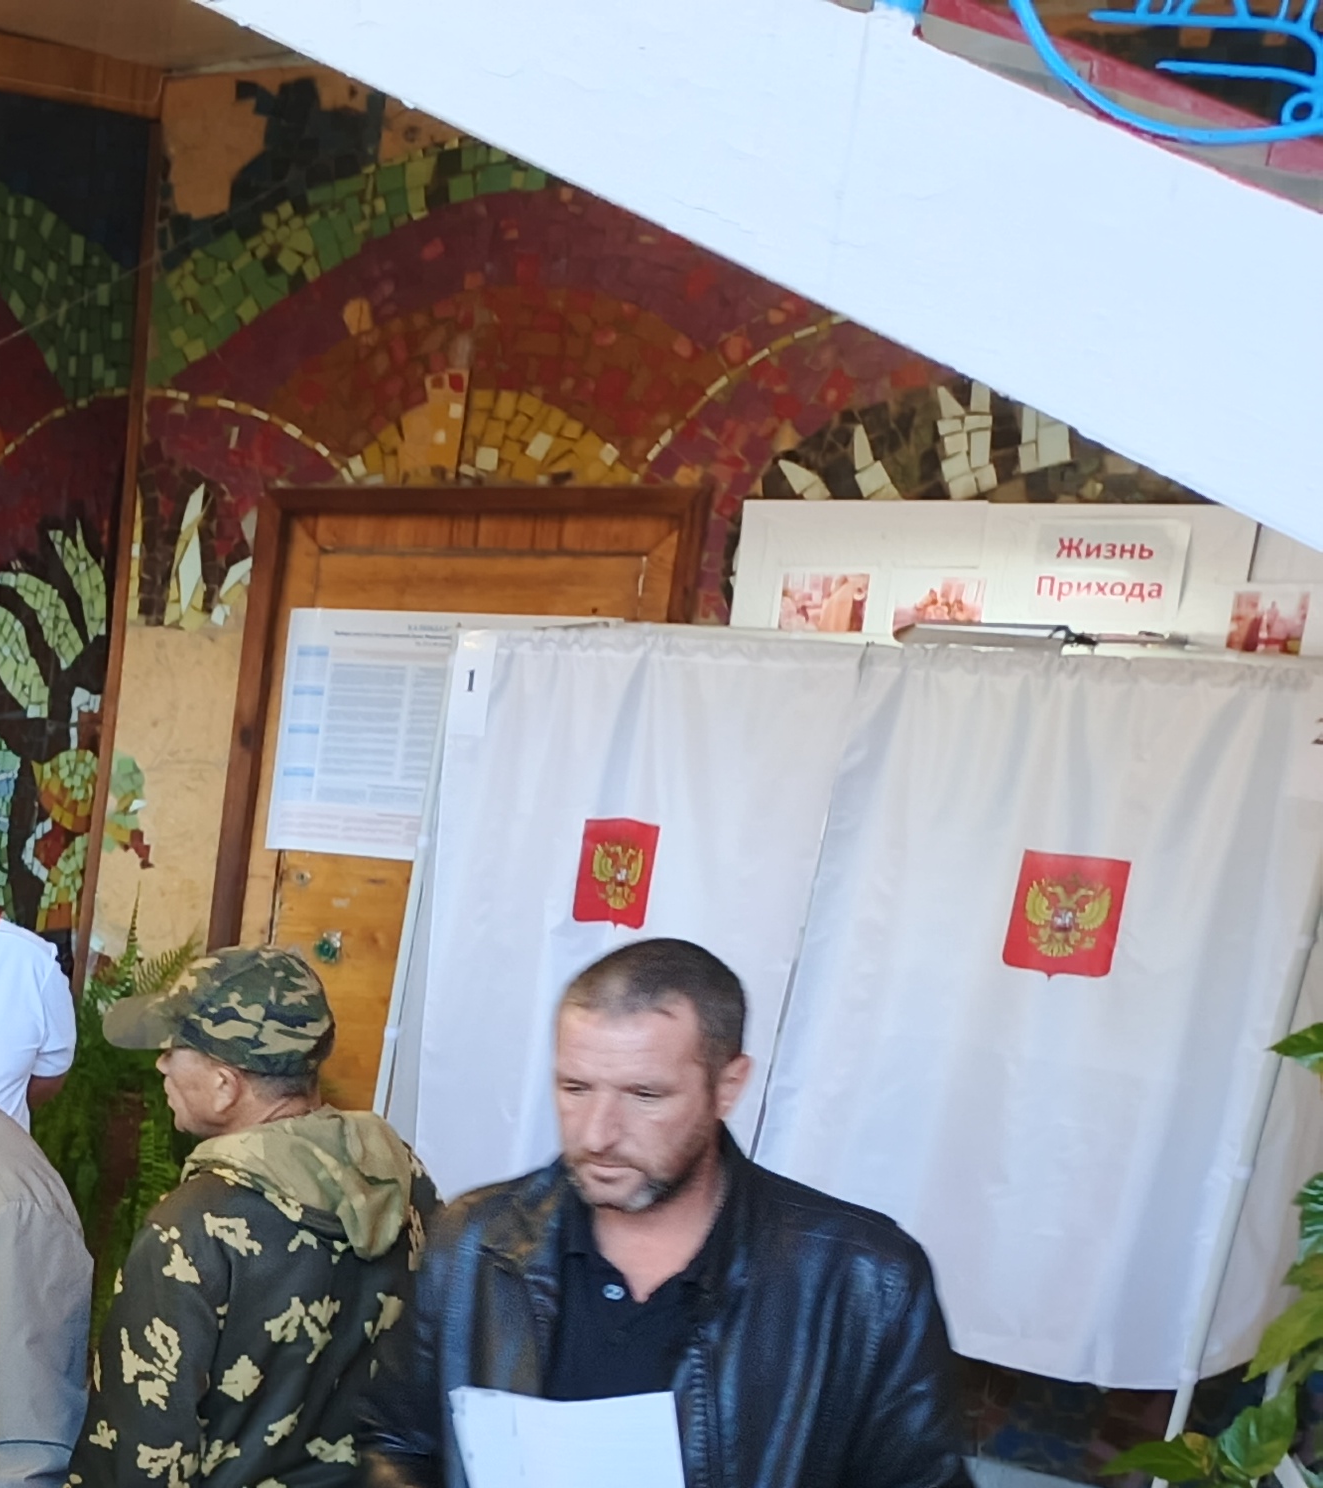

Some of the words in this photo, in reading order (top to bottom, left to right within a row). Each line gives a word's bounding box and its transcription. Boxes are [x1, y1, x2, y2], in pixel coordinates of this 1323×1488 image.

[1056, 537, 1154, 560] Жизнь
[1036, 575, 1163, 603] Прихода
[466, 669, 476, 692] 1
